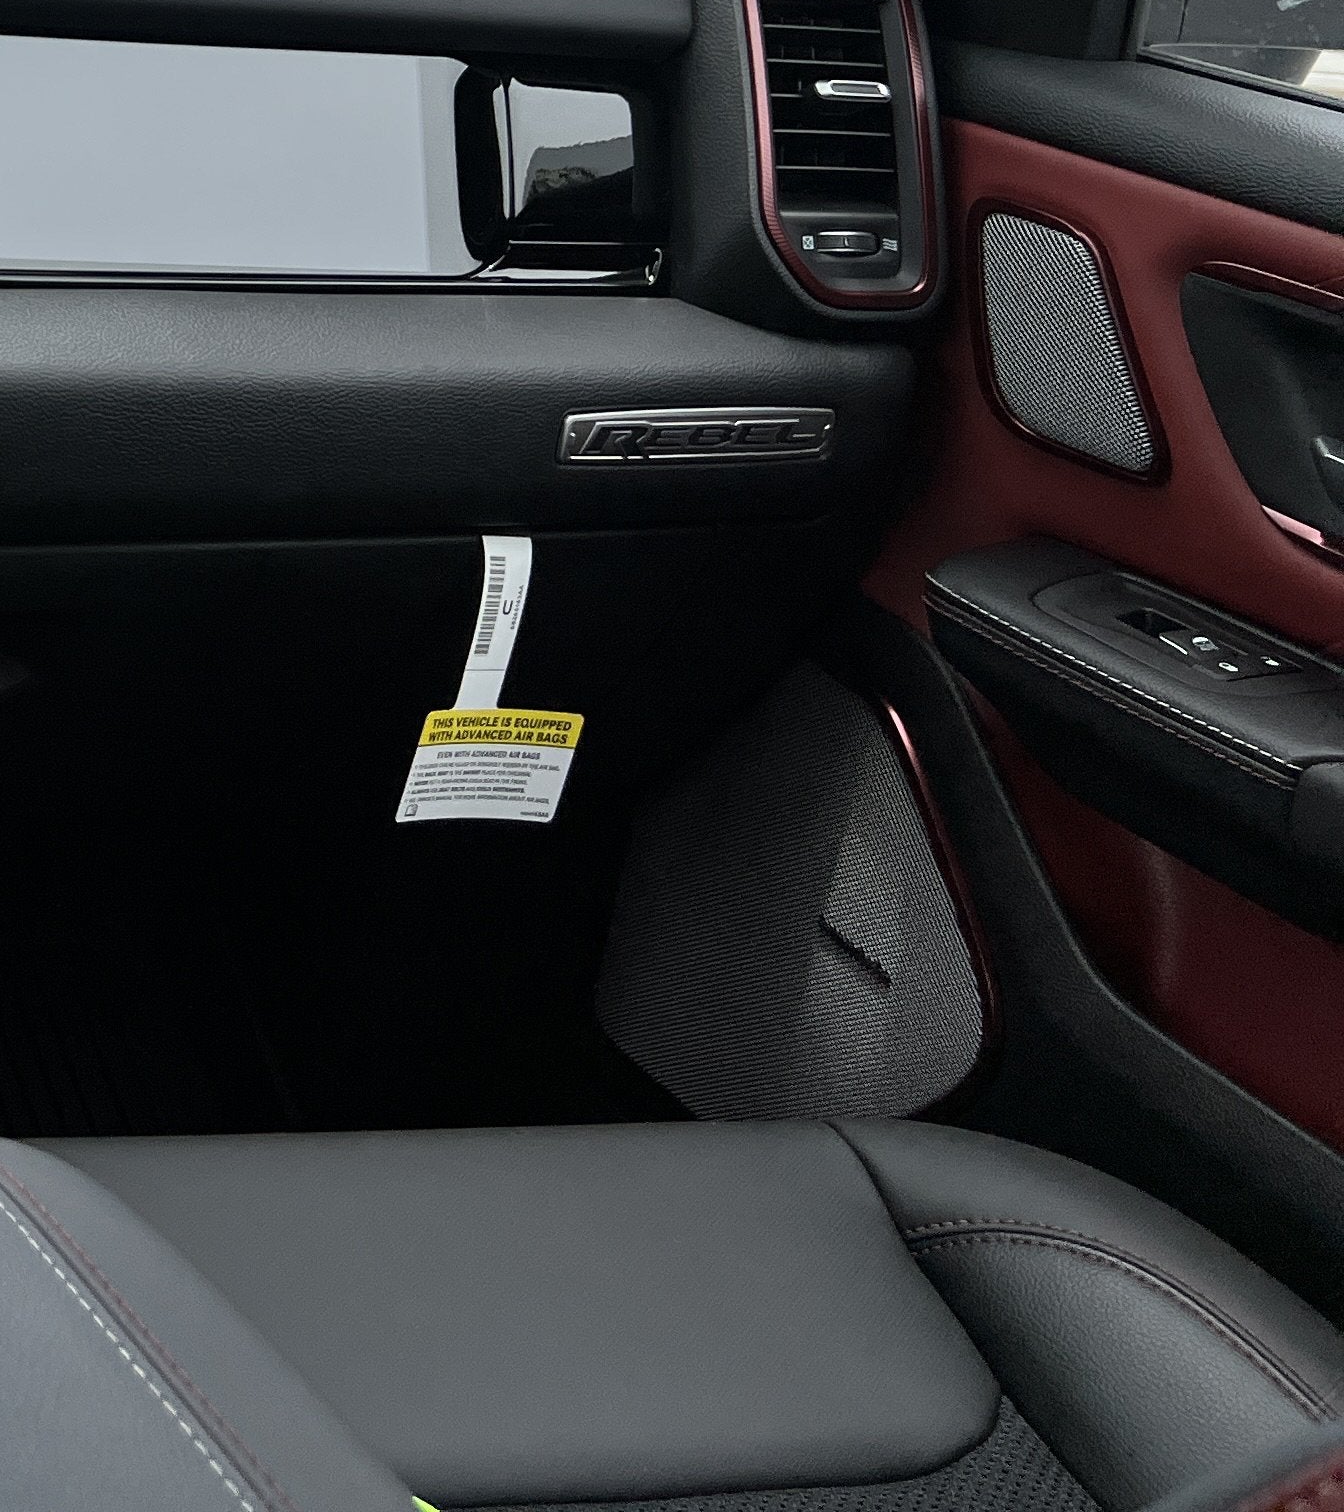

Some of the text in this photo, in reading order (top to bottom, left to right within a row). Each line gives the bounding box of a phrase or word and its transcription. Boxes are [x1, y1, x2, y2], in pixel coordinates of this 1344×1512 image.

[576, 417, 818, 455] REBEL
[432, 716, 572, 732] THIS VEHICLE IS EQUIPPED
[428, 729, 569, 745] WITH ADVANCED AIR BAGS
